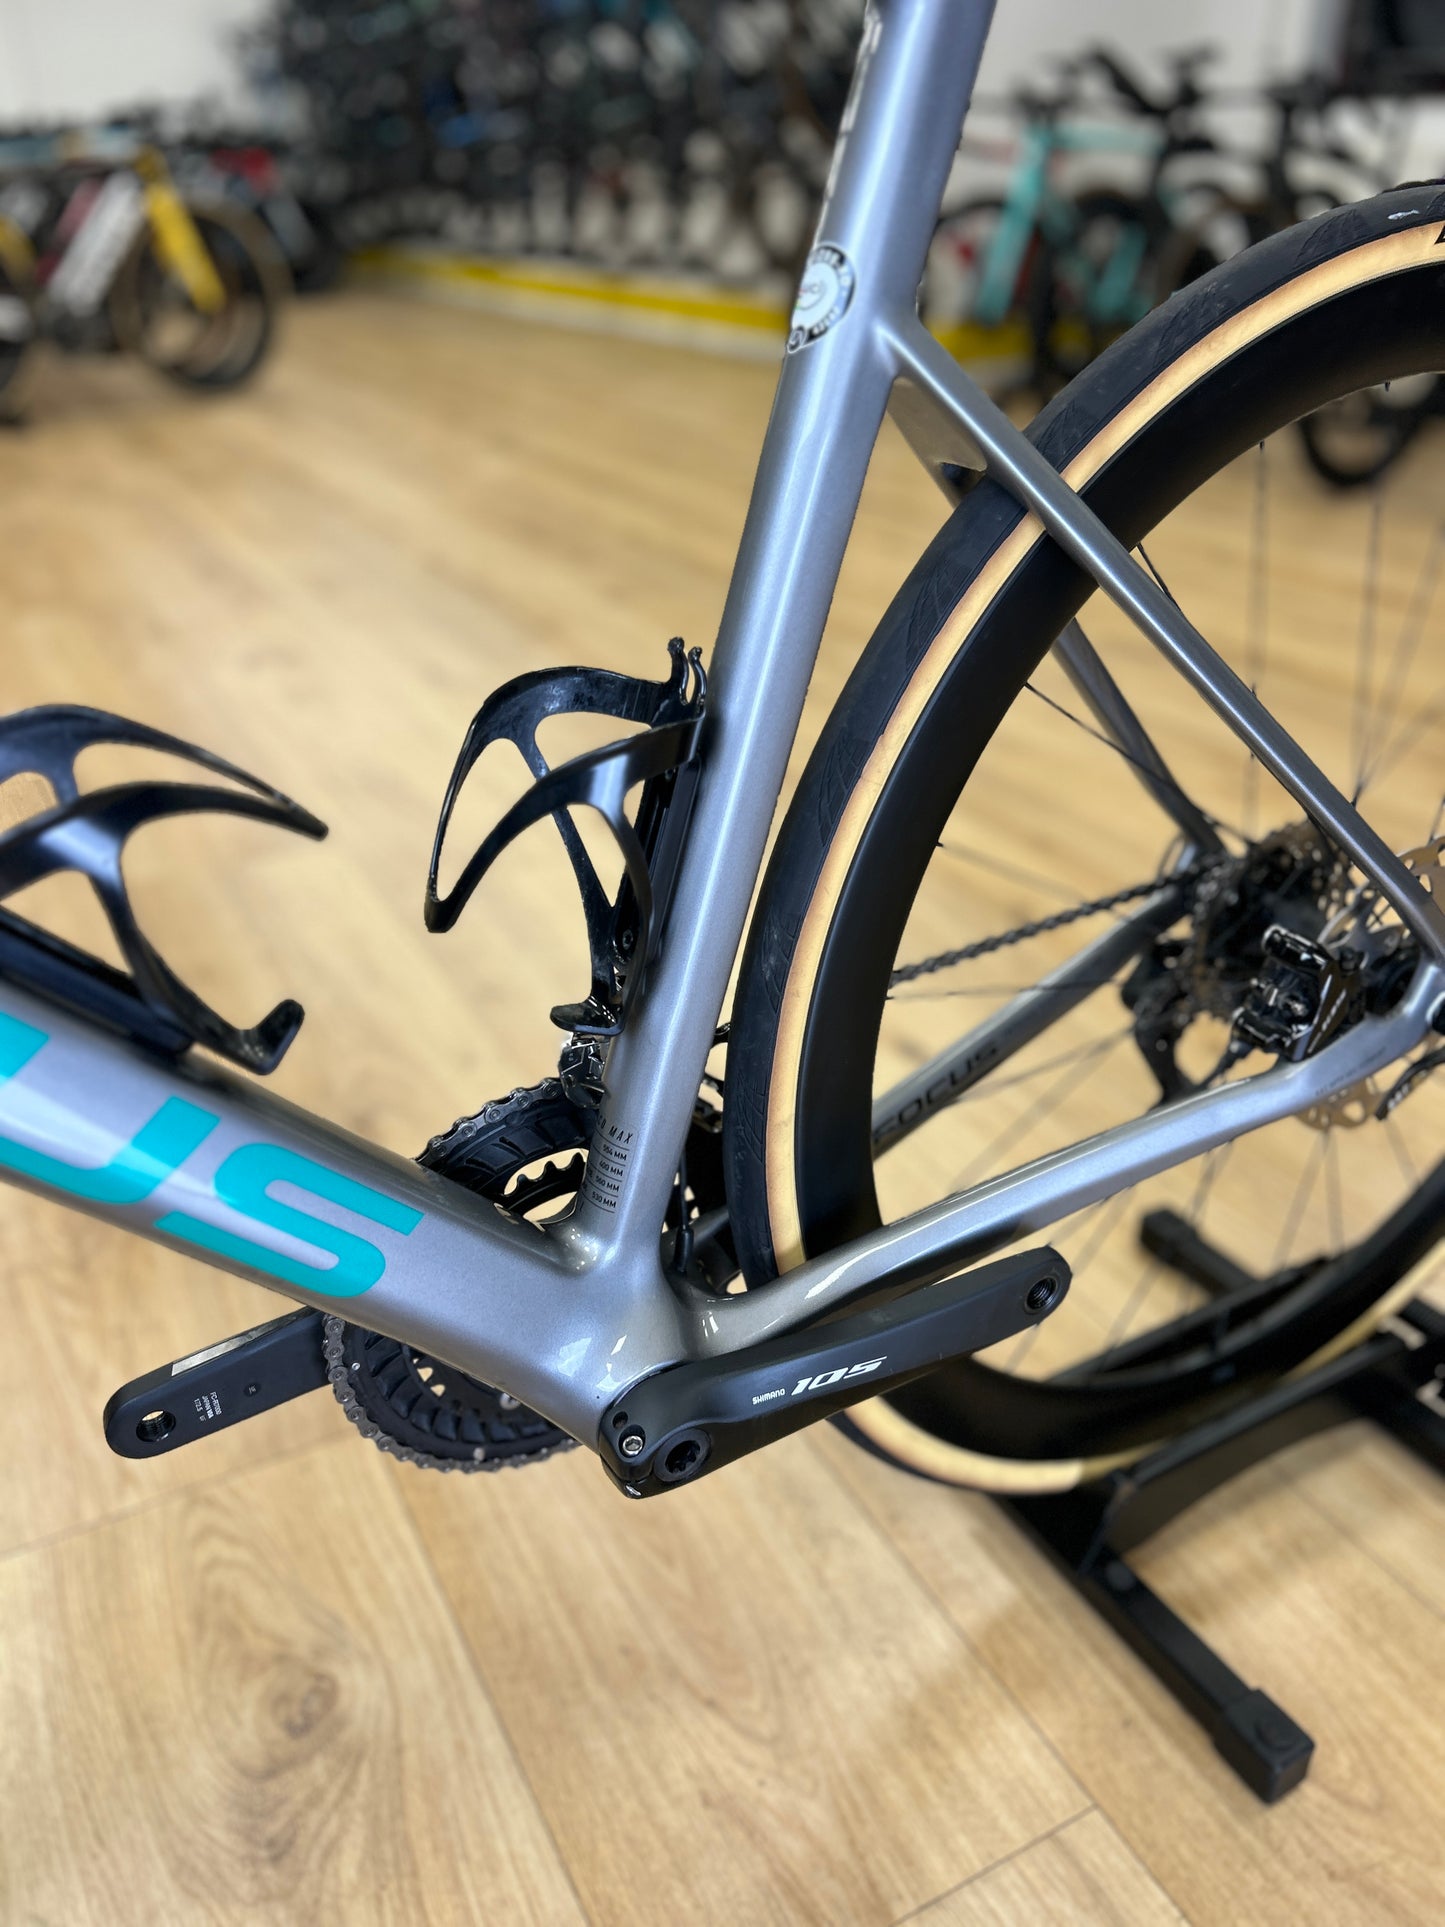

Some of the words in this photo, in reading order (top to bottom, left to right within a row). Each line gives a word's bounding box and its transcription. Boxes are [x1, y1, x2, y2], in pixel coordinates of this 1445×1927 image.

[608, 1125, 634, 1145] MAX
[614, 1149, 627, 1161] MM
[610, 1164, 624, 1177] MM
[606, 1181, 620, 1193] MM
[603, 1196, 617, 1209] MM
[752, 1388, 786, 1405] SHIMANO
[791, 1356, 887, 1396] 105
